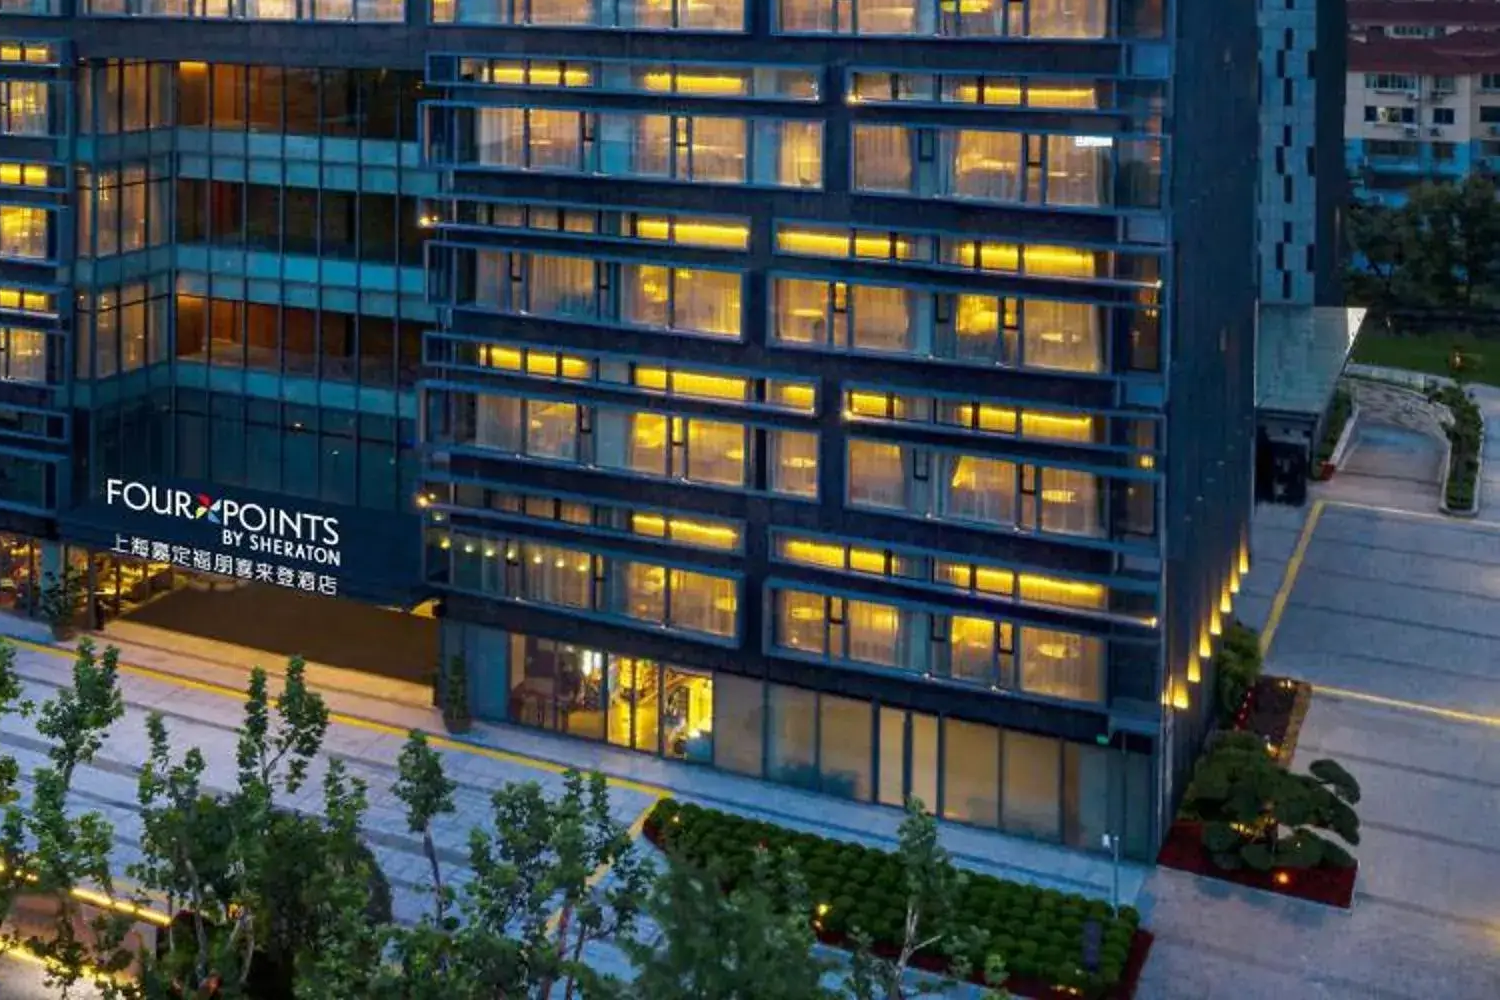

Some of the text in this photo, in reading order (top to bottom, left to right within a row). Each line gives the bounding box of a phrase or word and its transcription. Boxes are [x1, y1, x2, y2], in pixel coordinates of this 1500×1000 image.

[106, 479, 339, 545] FOUR POINTS
[112, 533, 337, 596] 上海嘉定福朋喜来登酒店
[223, 529, 341, 567] BY SHERATON
